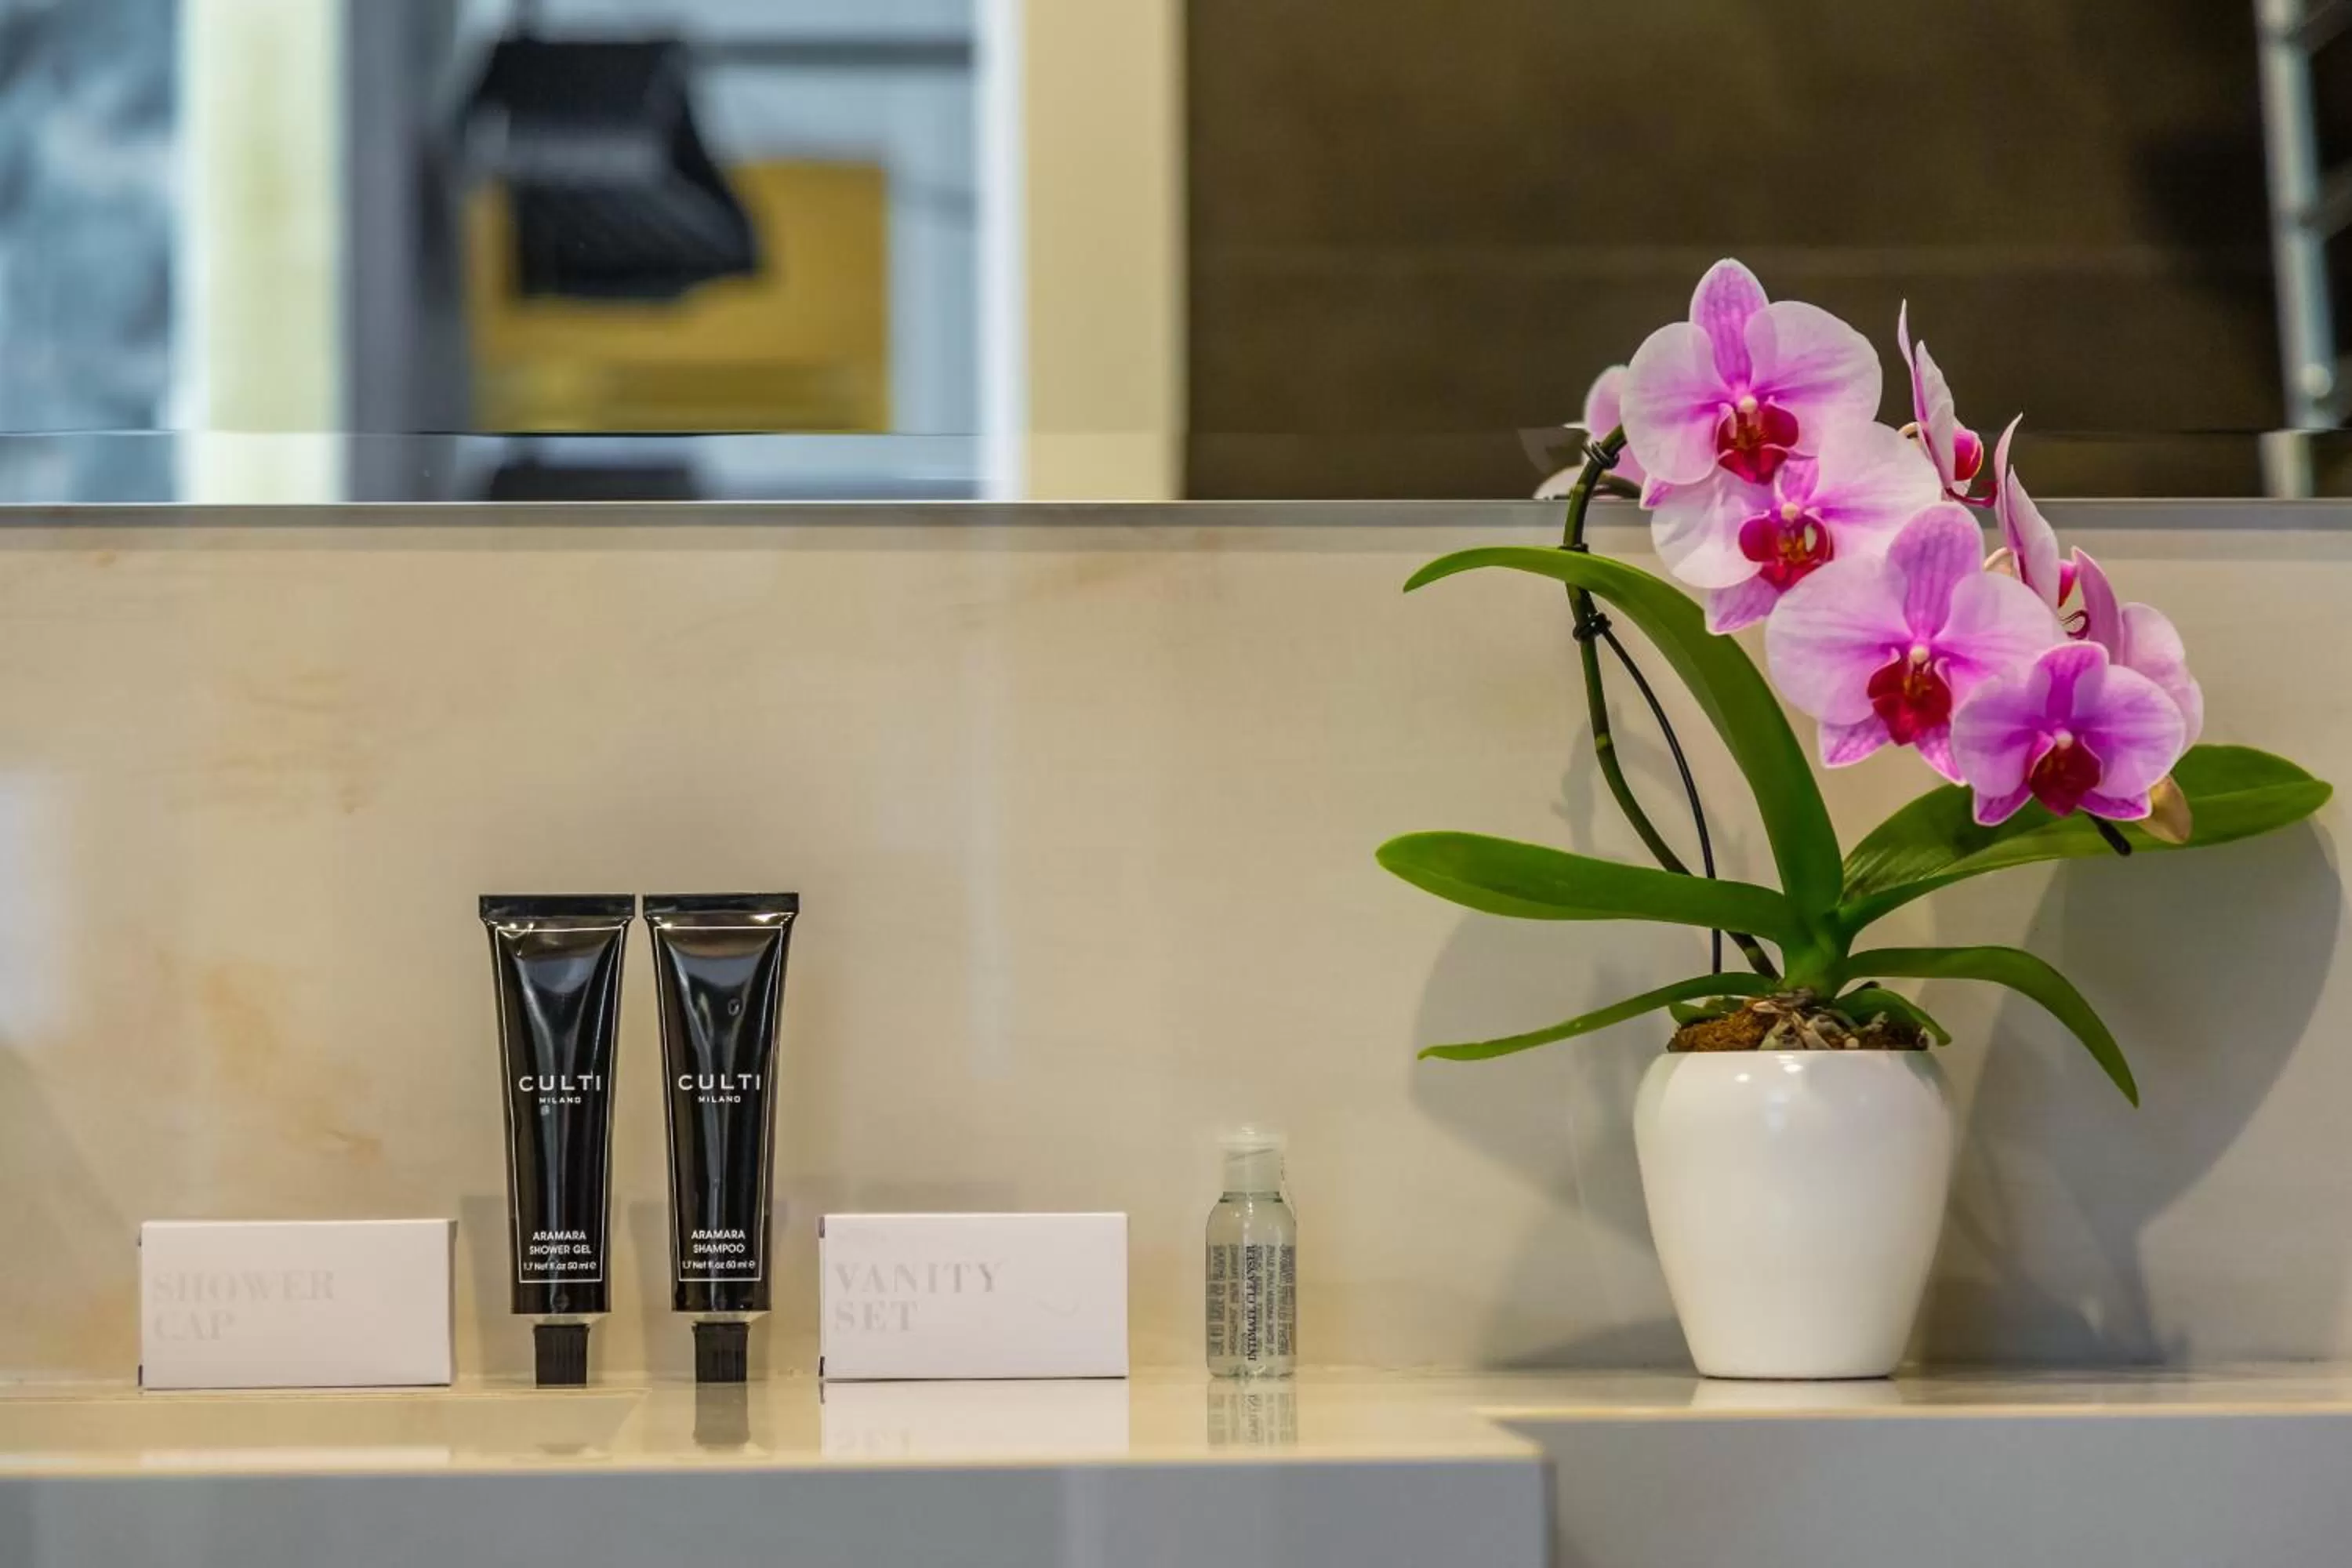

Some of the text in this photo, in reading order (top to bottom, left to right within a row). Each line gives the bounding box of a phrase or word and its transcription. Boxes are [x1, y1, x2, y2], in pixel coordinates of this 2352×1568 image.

[519, 1075, 601, 1092] CULTI
[678, 1073, 760, 1091] CULTI
[532, 1231, 586, 1240] ARAMARA
[691, 1229, 746, 1240] ARAMARA
[529, 1244, 592, 1254] SHOWER GEL
[692, 1243, 746, 1254] SHAMPOO
[152, 1269, 335, 1302] SHOWER
[833, 1261, 1004, 1294] VANITY
[1246, 1244, 1257, 1362] INTIMATE CLEANSER
[153, 1310, 237, 1341] CAP
[833, 1300, 918, 1333] SET
